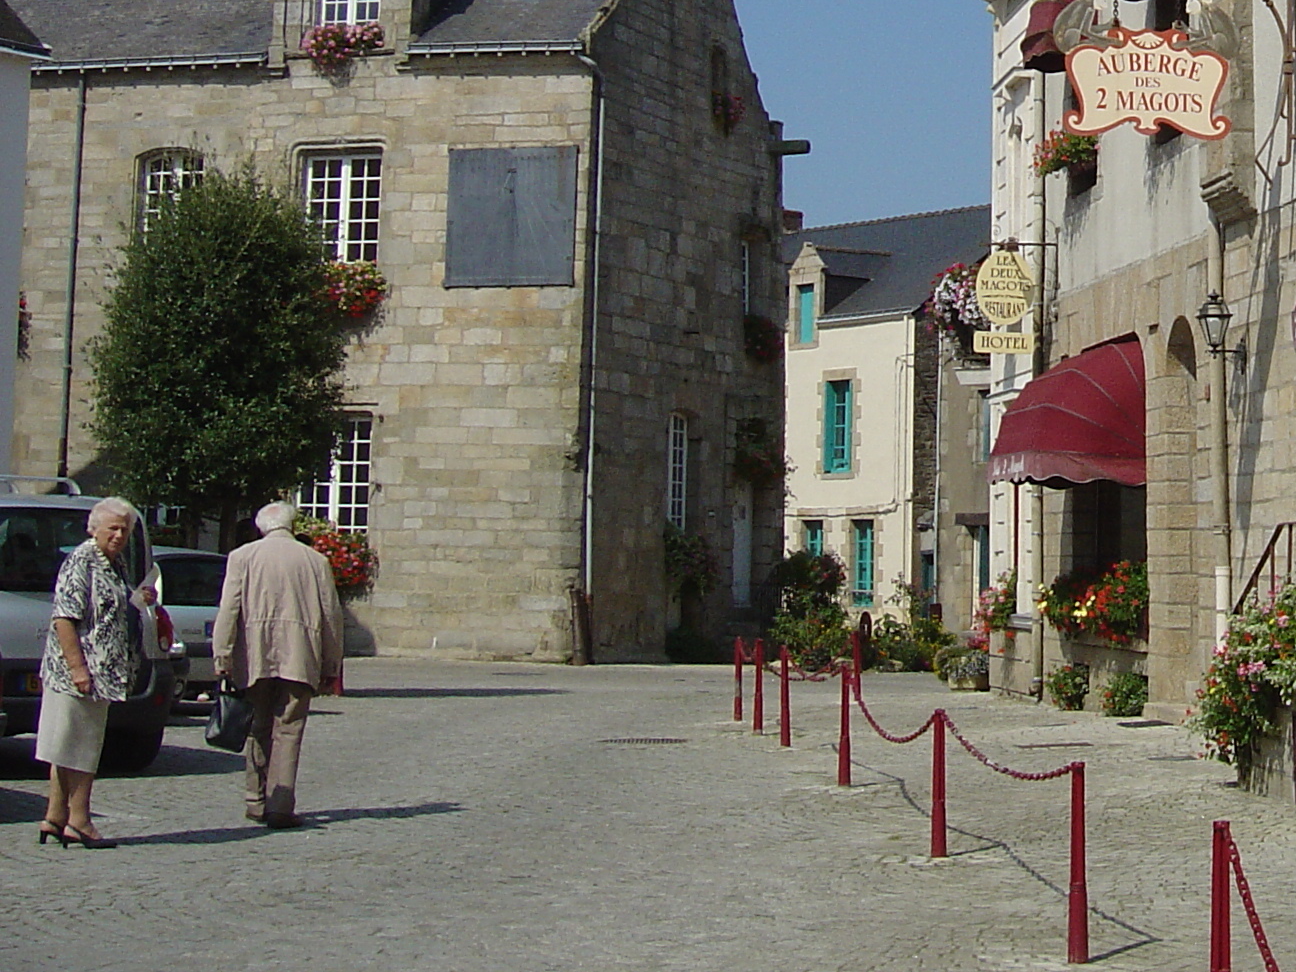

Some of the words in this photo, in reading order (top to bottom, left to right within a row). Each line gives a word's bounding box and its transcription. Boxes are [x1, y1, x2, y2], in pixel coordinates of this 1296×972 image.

[1097, 52, 1204, 83] AUBERGE
[1134, 76, 1161, 88] DES
[1095, 87, 1107, 109] 2
[1115, 89, 1203, 114] MAGOTS
[996, 255, 1017, 266] LES
[990, 268, 1023, 279] DEUX
[980, 279, 1031, 292] MAGOTS
[984, 301, 1026, 319] RESTAURANT
[981, 335, 1028, 350] HOTEL
